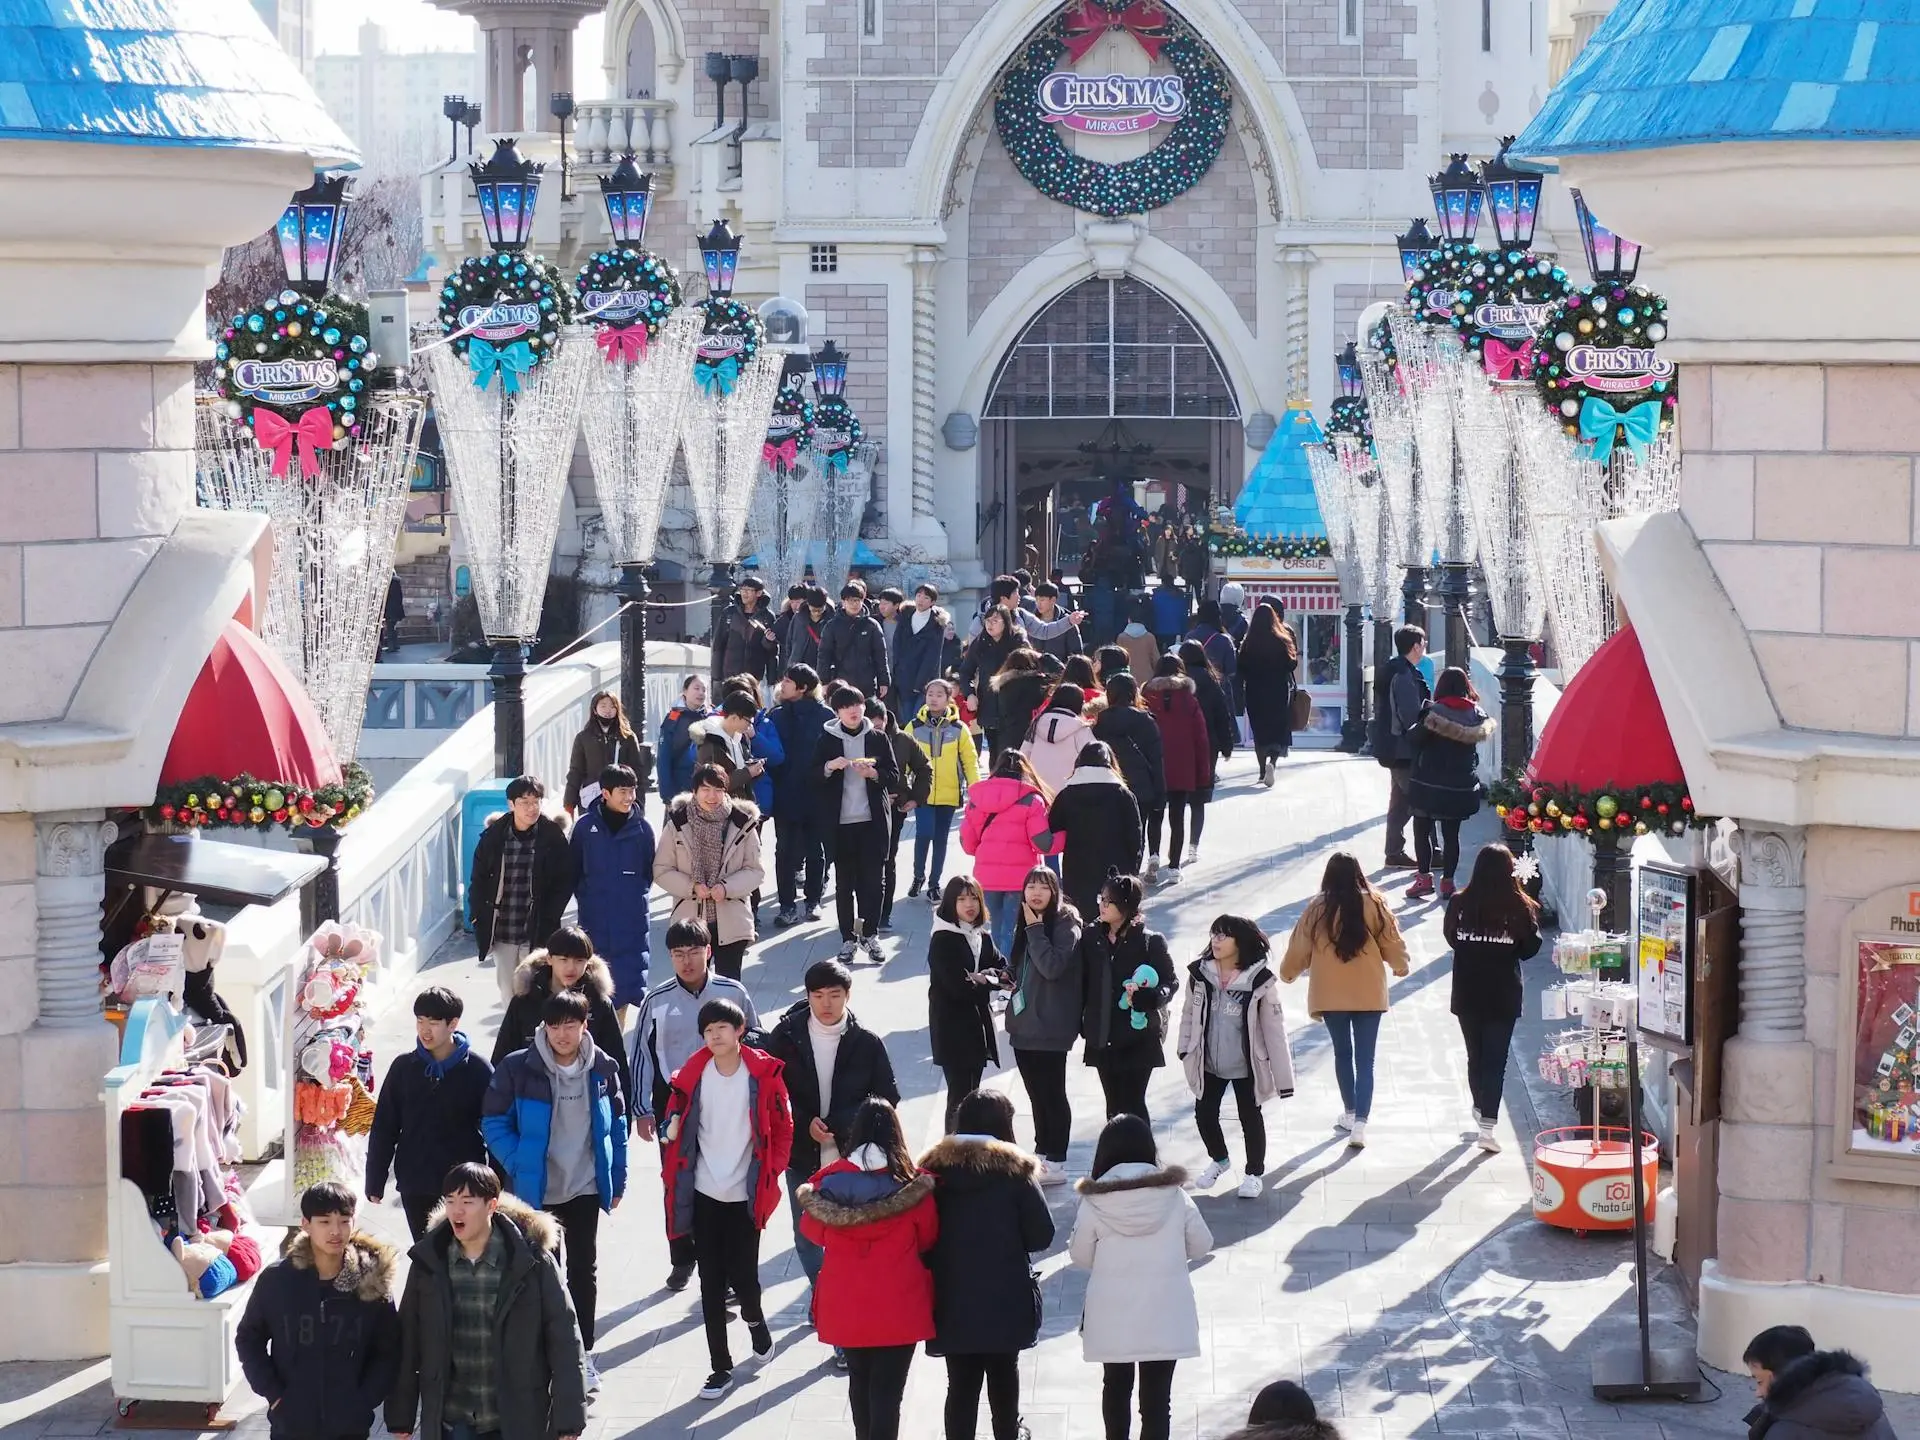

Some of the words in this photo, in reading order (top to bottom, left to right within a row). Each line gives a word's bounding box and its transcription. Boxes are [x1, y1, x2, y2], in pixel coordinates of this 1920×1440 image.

[1042, 76, 1181, 112] CHRISTMAS
[1085, 119, 1140, 131] MIRACLE
[1477, 305, 1550, 326] CHRITMA
[486, 329, 516, 338] MIRACLE
[237, 361, 336, 388] CHRISTMAS
[1600, 379, 1640, 389] MIRACLE
[268, 391, 308, 401] MIRACLE
[1592, 1202, 1620, 1213] Photo
[1621, 1202, 1633, 1212] Cu
